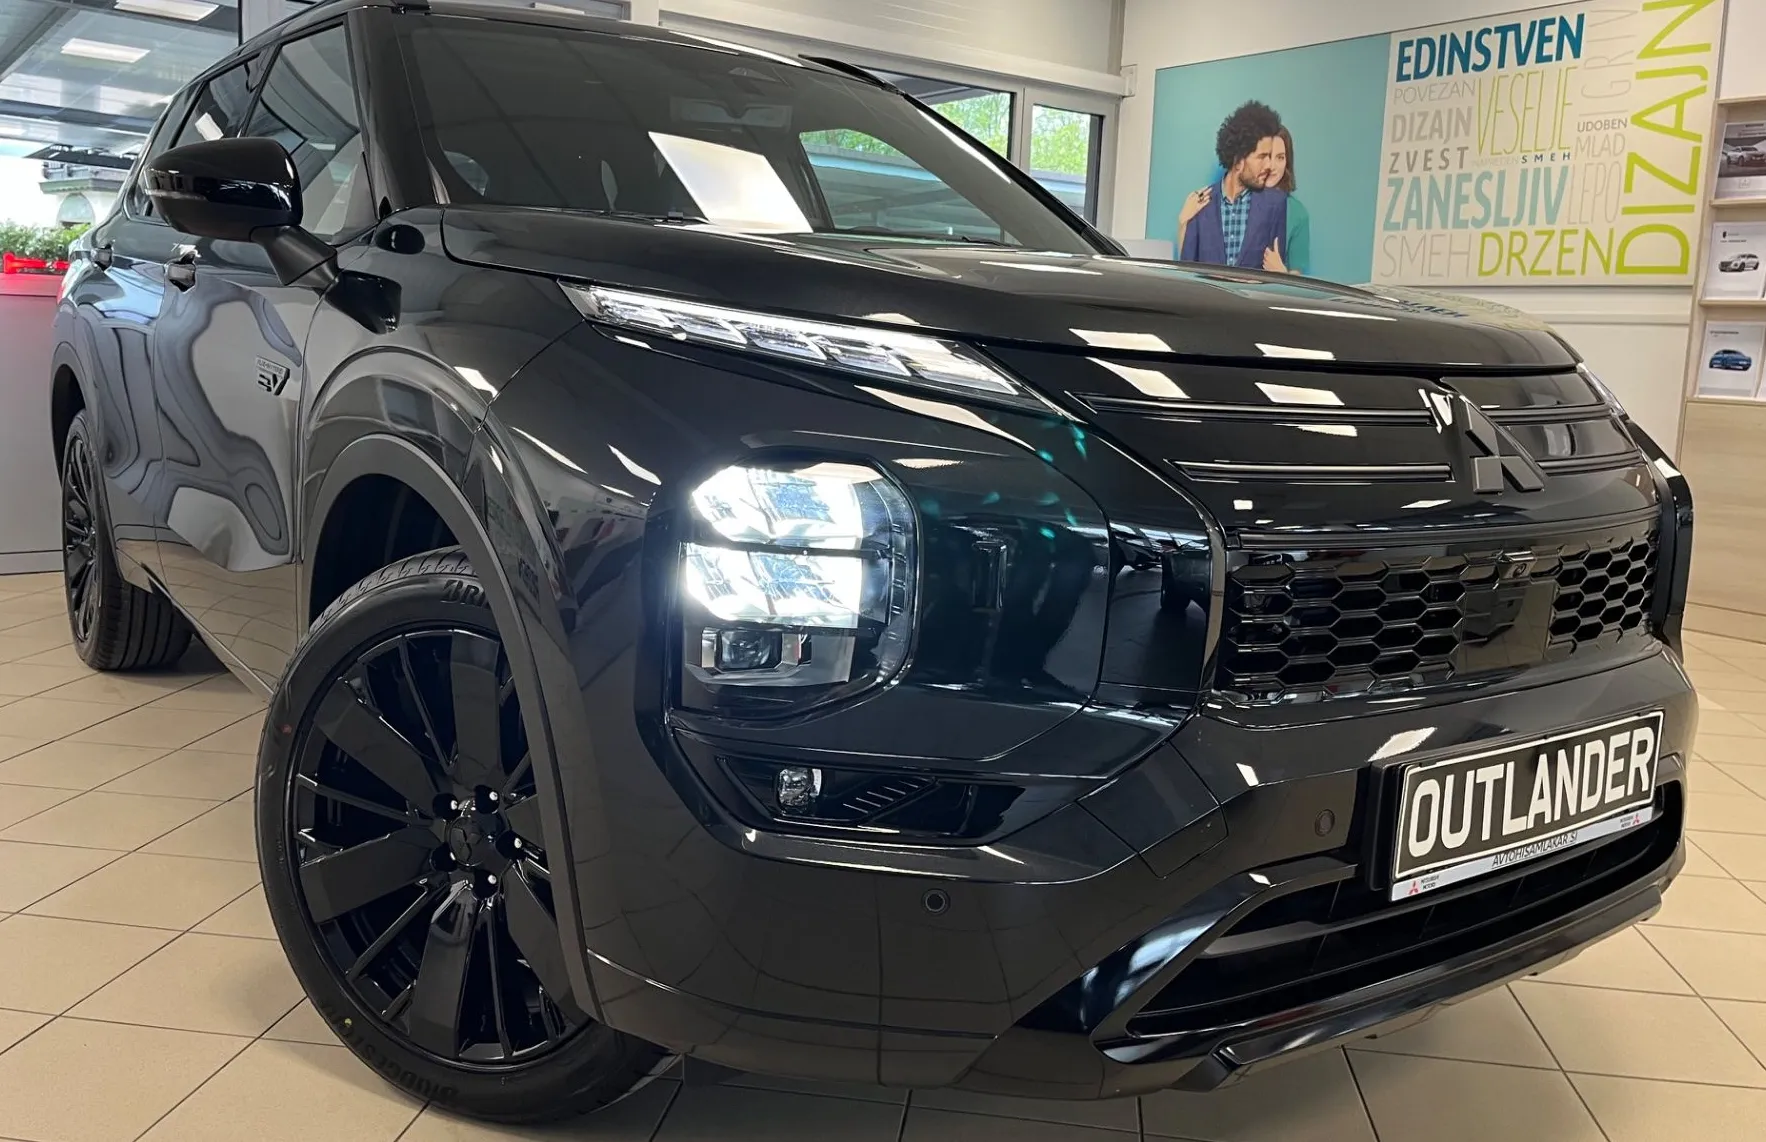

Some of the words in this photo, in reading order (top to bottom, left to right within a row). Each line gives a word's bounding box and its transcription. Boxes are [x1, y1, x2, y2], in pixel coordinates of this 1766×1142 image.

[1396, 13, 1585, 82] EDINSTVEN
[1393, 78, 1476, 105] POVEZAN
[1478, 66, 1578, 157] VESELJE
[1391, 106, 1473, 145] DIZAJN
[1575, 133, 1626, 161] MLAD
[1577, 118, 1628, 133] UDOBEN
[1615, 0, 1716, 275] DIZAJN
[1388, 146, 1469, 174] ZVEST
[1521, 152, 1571, 164] SMEH
[1383, 165, 1569, 231] ZANESLJIV
[1567, 161, 1622, 225] LEPO
[1380, 233, 1472, 278] SMEH
[1478, 228, 1614, 276] DRZEN
[1408, 726, 1655, 858] OUTLANDER
